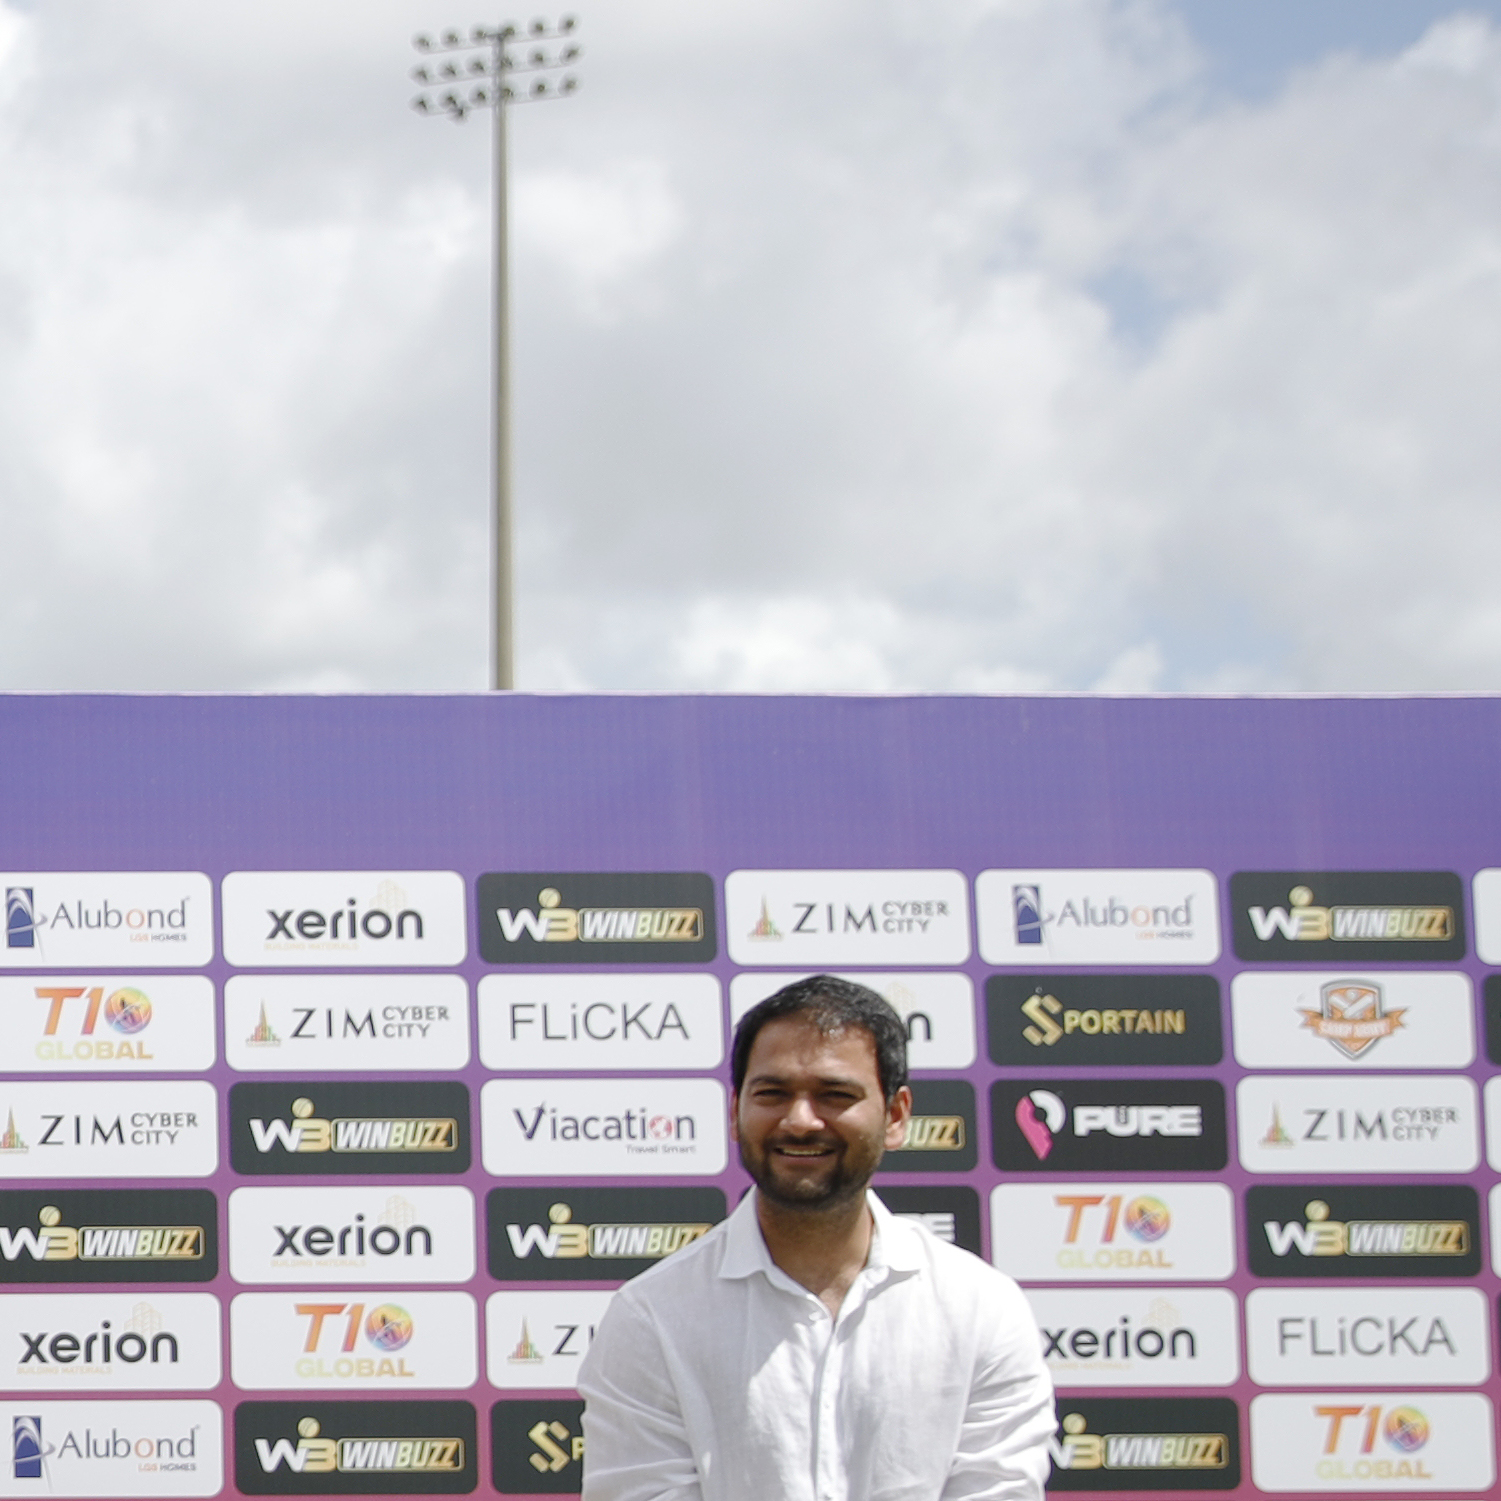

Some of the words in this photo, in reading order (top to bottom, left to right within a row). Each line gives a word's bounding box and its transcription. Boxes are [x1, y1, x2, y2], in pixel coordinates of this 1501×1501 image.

[267, 899, 423, 941] xerion
[1057, 897, 1194, 928] Alubond
[335, 1120, 453, 1150] WINBUZZ
[1074, 1106, 1202, 1137] PURE
[1278, 1318, 1455, 1356] FLiCKA
[57, 1429, 197, 1460] Alubond
